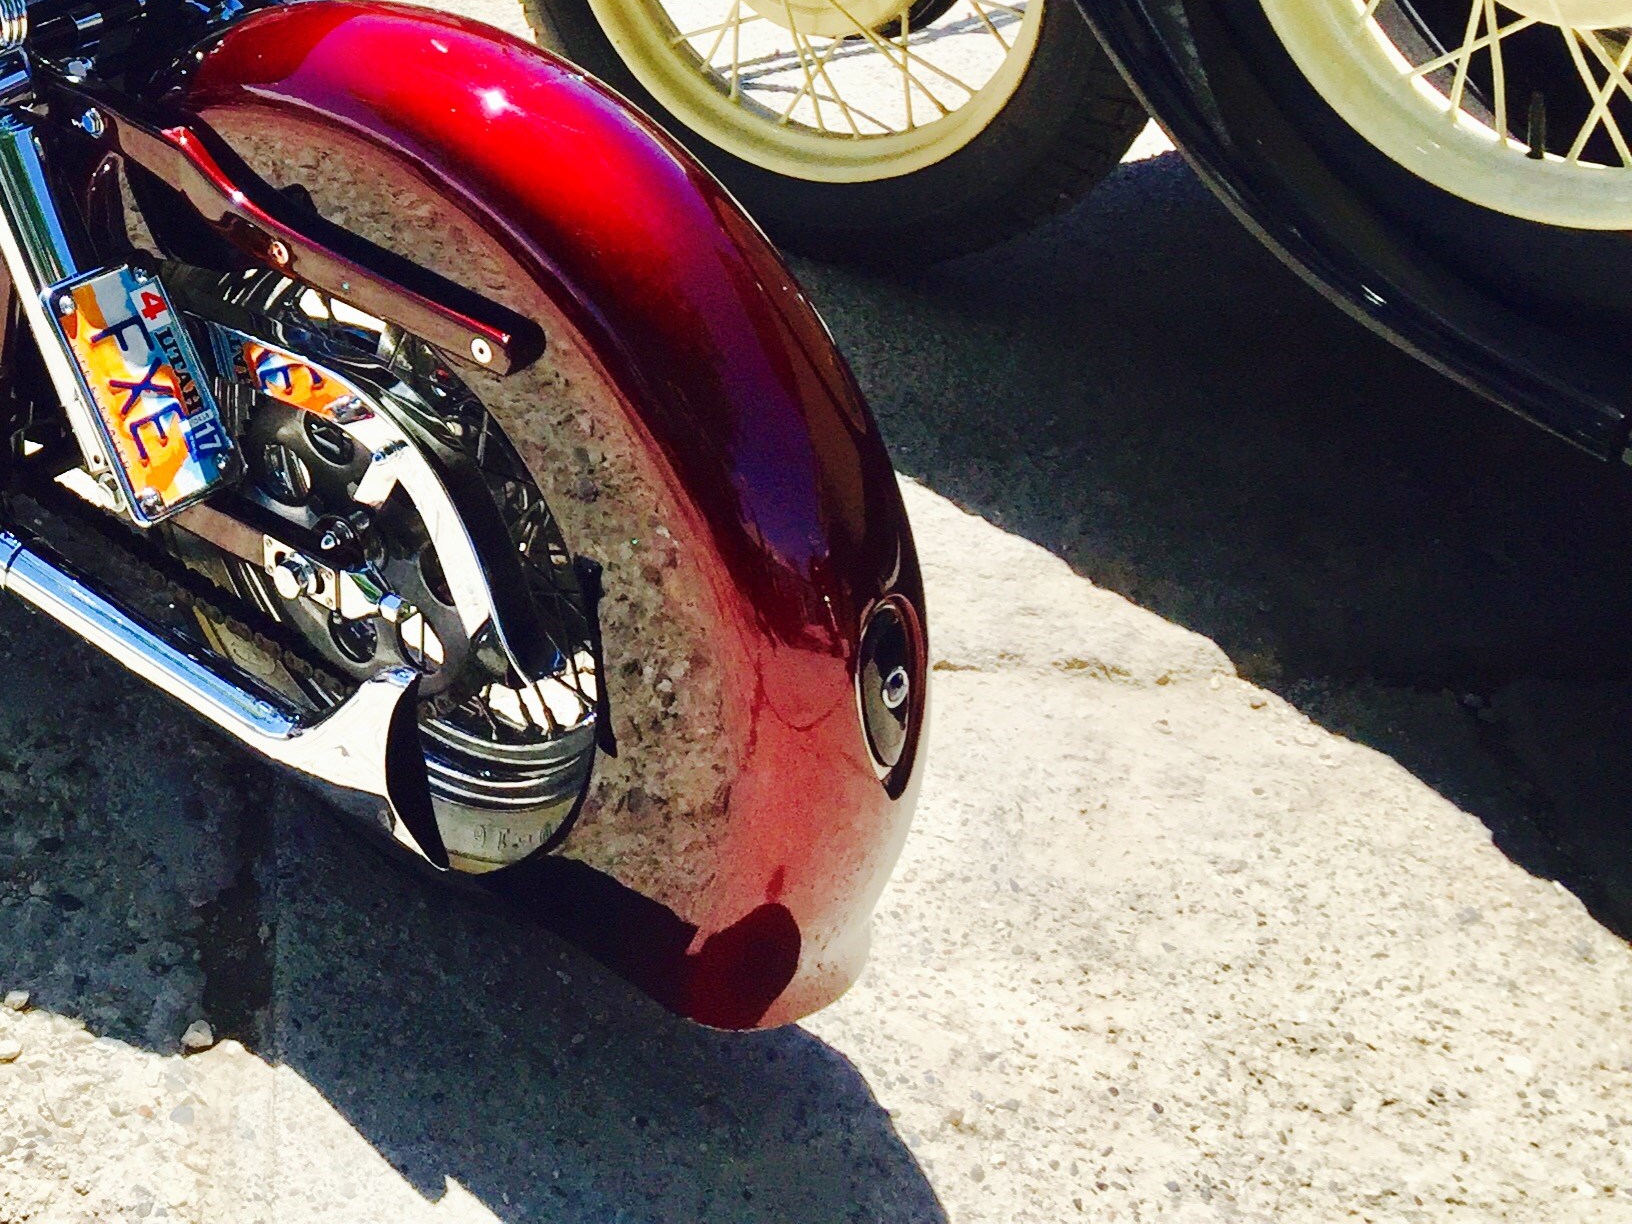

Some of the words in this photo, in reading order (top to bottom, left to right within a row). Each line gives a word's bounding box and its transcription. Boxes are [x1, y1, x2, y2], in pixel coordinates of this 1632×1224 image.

[140, 291, 168, 321] 4
[90, 314, 190, 464] FXE
[154, 327, 204, 415] UTAH
[194, 422, 223, 451] 17
